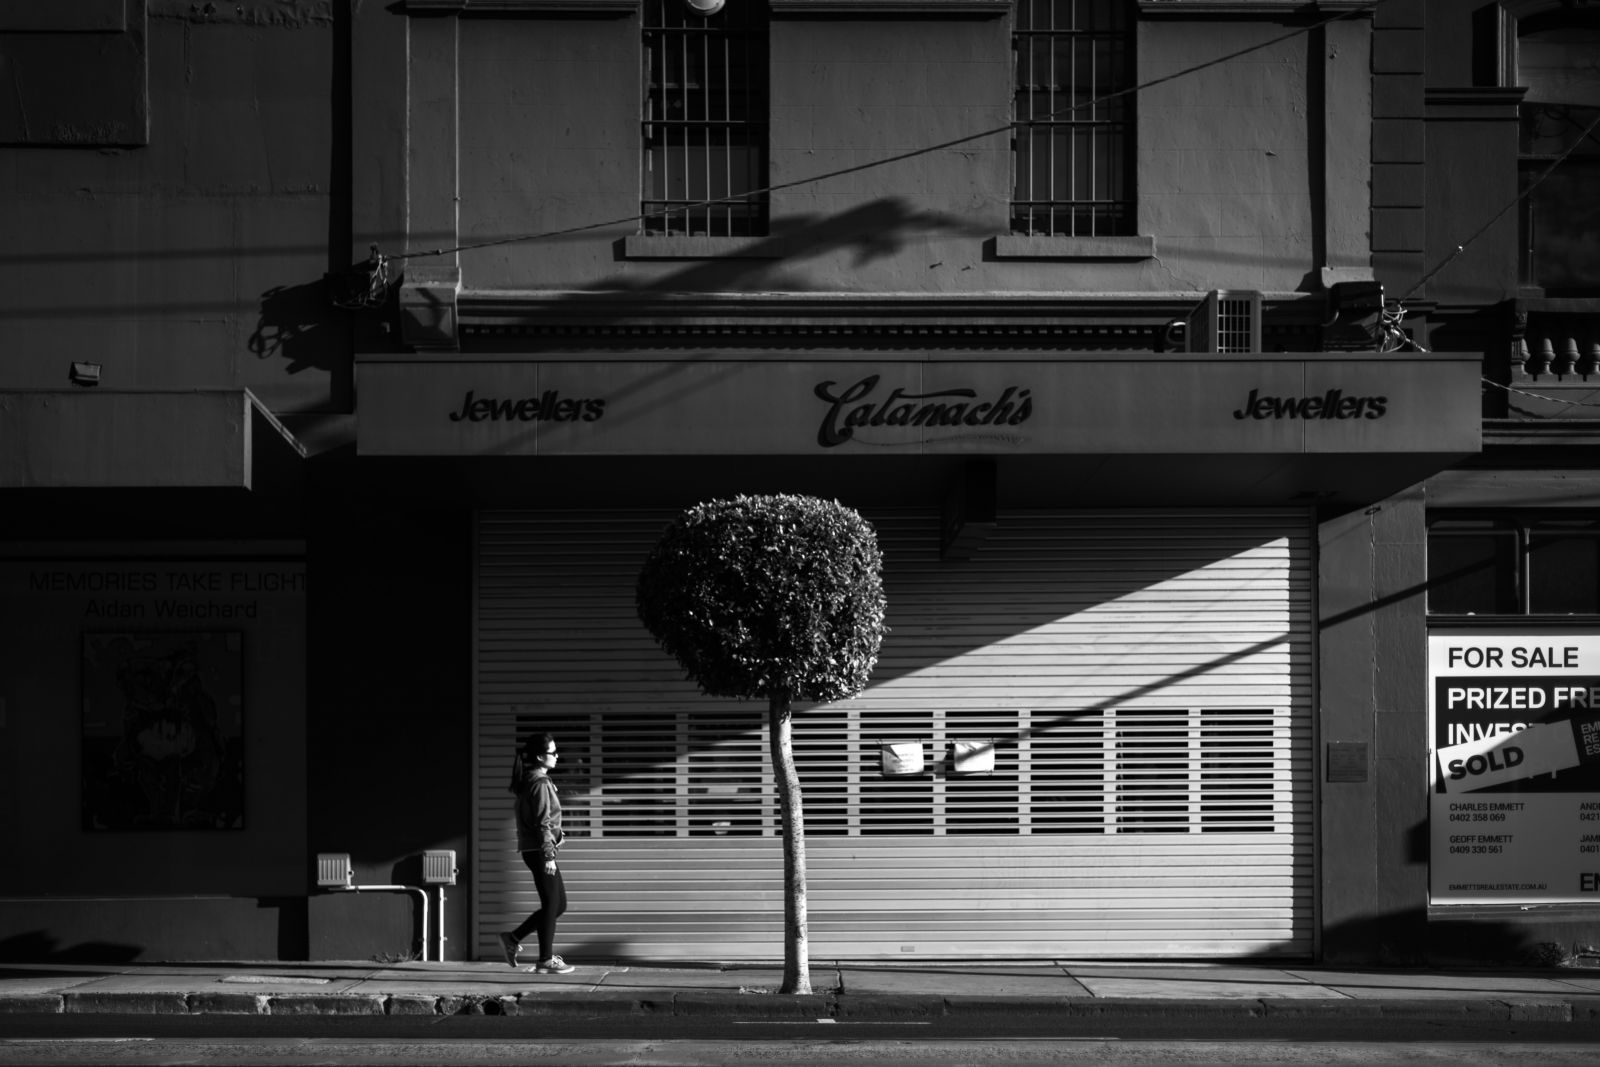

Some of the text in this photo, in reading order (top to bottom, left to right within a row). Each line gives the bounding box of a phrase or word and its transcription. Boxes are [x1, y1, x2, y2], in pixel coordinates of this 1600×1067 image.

[449, 389, 606, 422] Jewellers
[814, 374, 1033, 448] Catanach's
[1233, 388, 1388, 420] Jewellers
[29, 571, 306, 592] MEMORIES TAKE FLIGHT
[84, 599, 258, 618] Aidan Weichard
[1448, 646, 1579, 669] FOR SALE
[1448, 687, 1547, 710] PRIZED
[1448, 746, 1524, 780] SOLD
[1449, 802, 1525, 811] CHARLES EMMETT
[1580, 802, 1600, 811] AND
[1449, 813, 1506, 822] 0402 358 069
[1449, 834, 1513, 843] GEOFF EMMETT
[1580, 834, 1600, 843] JAM
[1449, 845, 1470, 854] 0409
[1471, 845, 1487, 854] 330
[1448, 883, 1547, 891] EMMETTSREALESTATE.COM.AU
